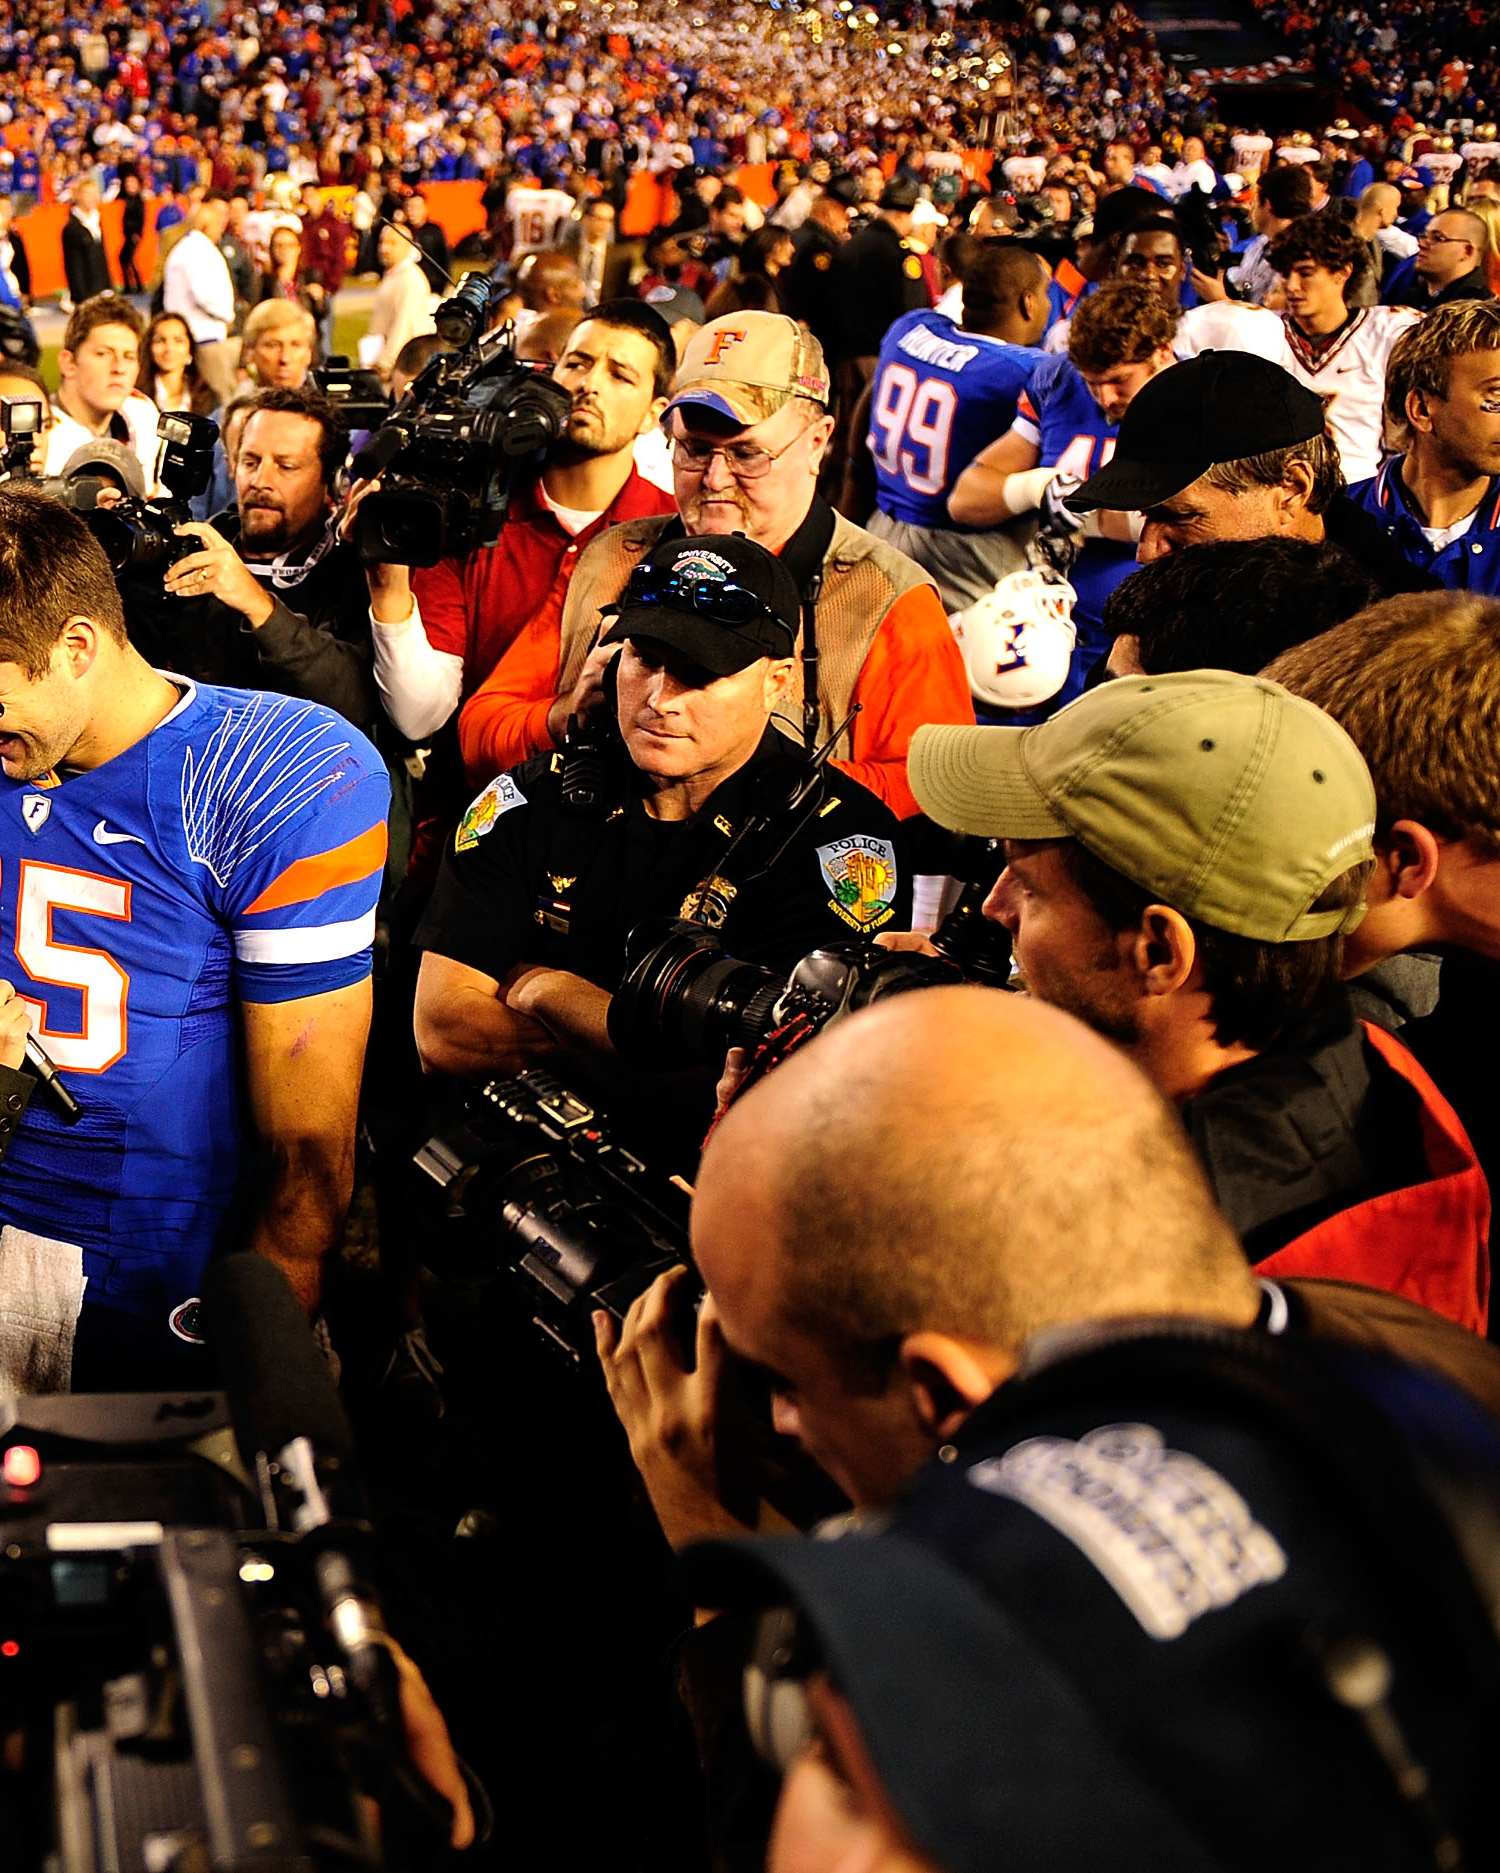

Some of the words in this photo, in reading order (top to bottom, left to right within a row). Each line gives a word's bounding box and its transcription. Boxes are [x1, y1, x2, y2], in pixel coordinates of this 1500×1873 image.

[703, 329, 748, 366] F
[865, 362, 960, 496] 99
[677, 549, 738, 574] UNIVERSITY
[28, 801, 45, 818] F
[827, 836, 888, 859] POLICE
[827, 899, 861, 932] UNIVERSITY
